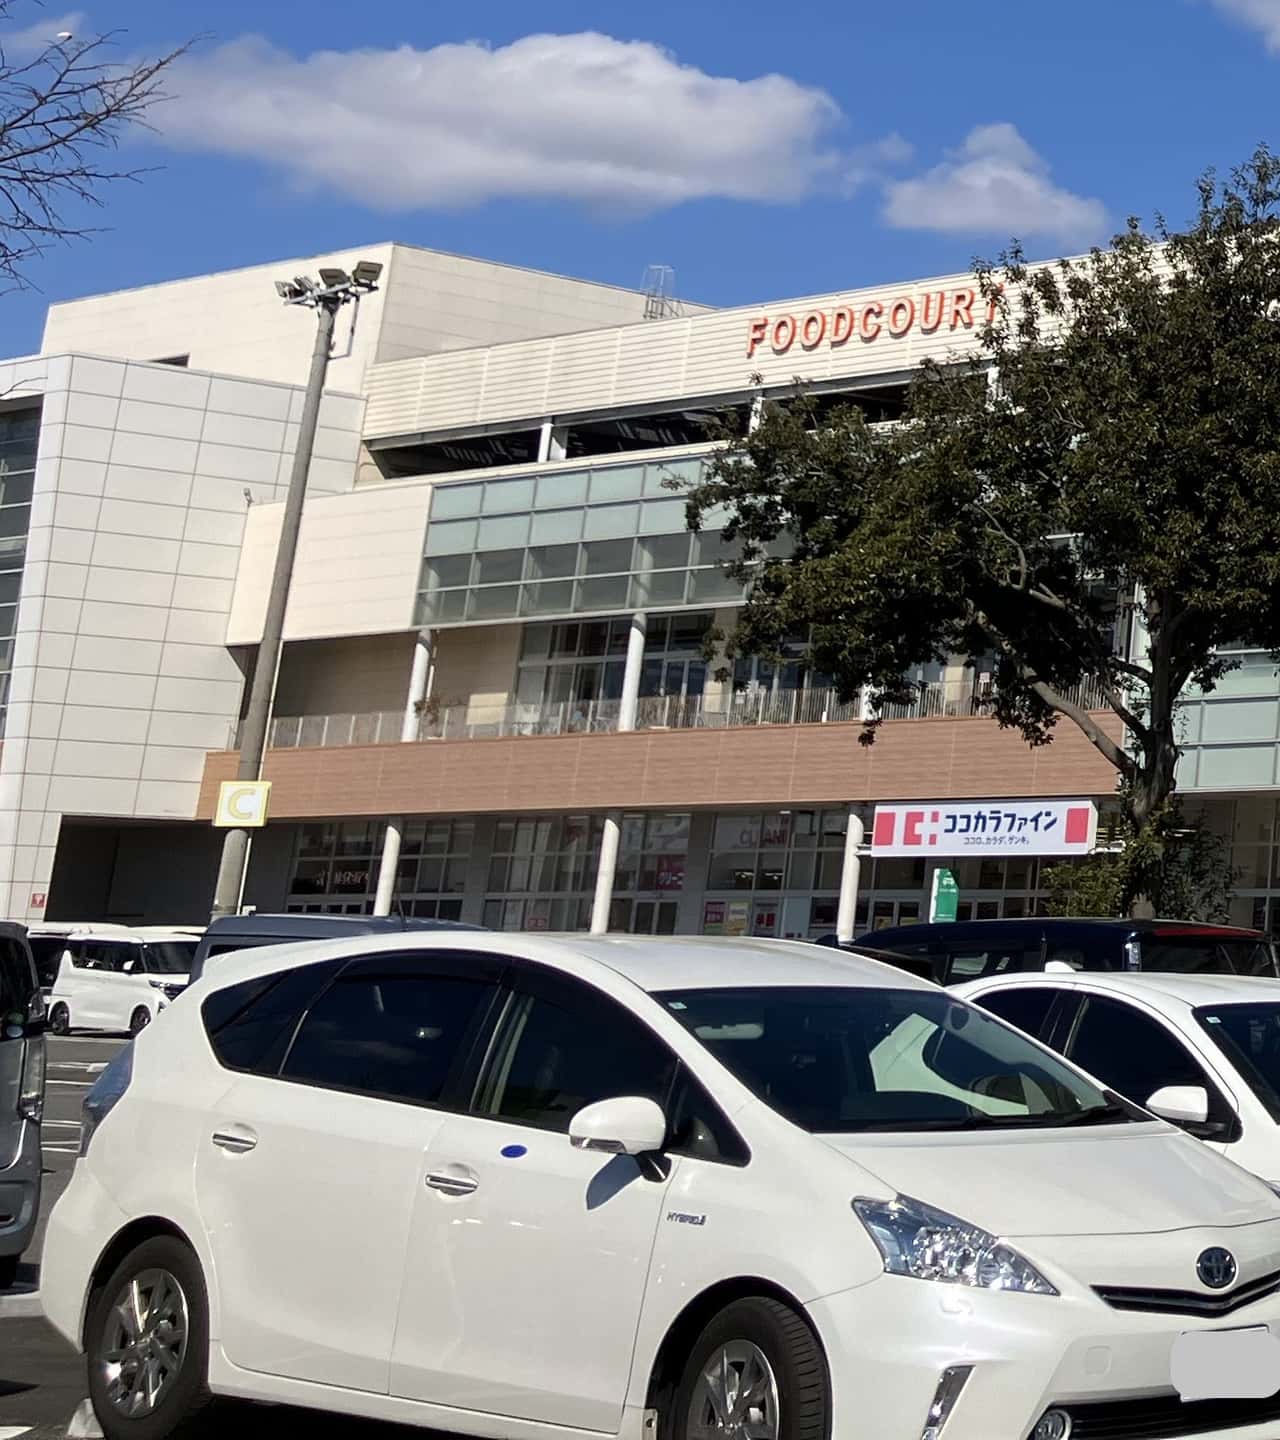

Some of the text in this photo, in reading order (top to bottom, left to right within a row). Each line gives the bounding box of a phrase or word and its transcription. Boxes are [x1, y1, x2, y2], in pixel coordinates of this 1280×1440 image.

[746, 282, 1004, 359] FOODCOURT
[228, 788, 257, 820] C
[943, 810, 1058, 833] ココカラファイン
